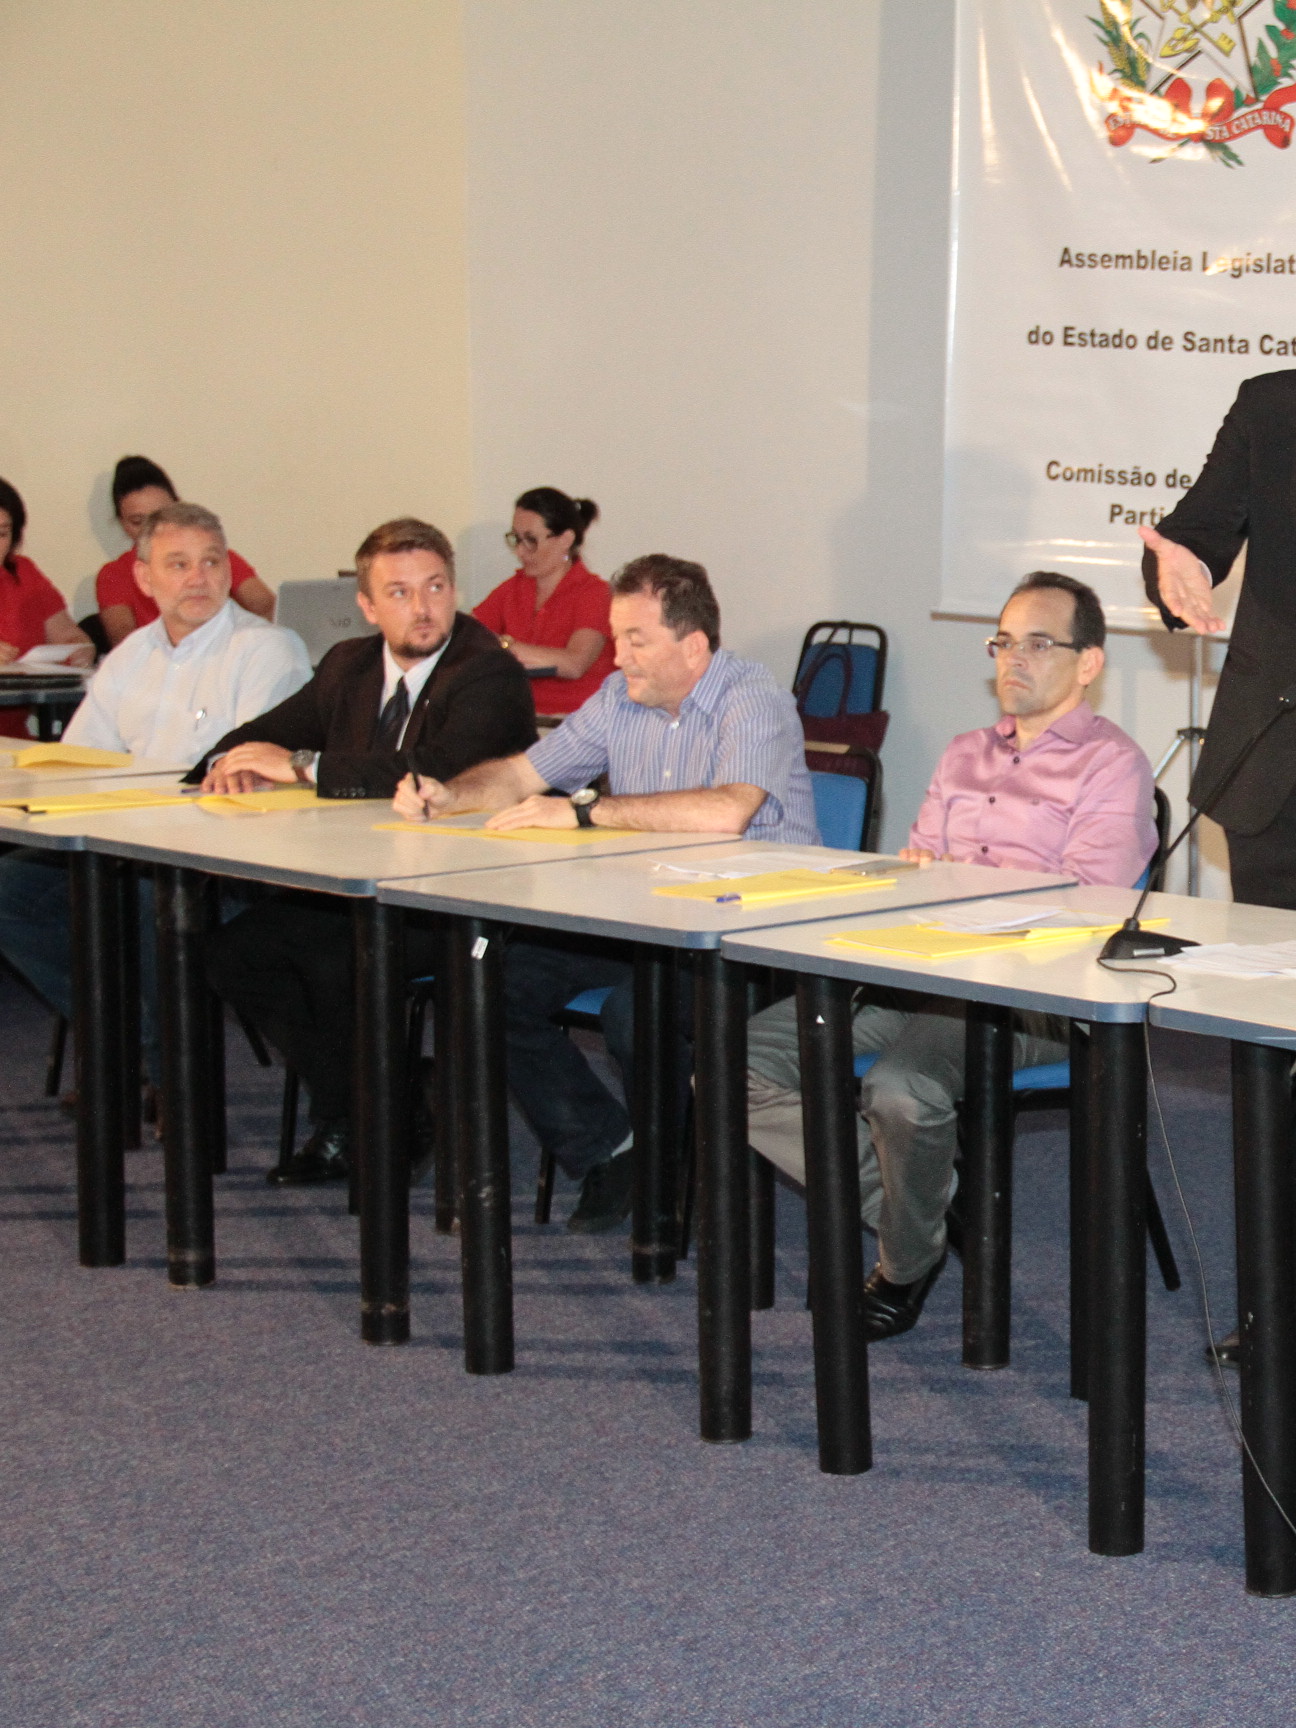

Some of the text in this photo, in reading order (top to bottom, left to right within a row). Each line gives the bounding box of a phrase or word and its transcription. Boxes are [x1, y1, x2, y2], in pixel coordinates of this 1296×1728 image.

[1232, 110, 1291, 133] CATARINA
[1059, 247, 1193, 271] Assembleia
[1027, 325, 1054, 345] do
[1063, 326, 1138, 349] Estado
[1146, 330, 1174, 351] de
[1182, 331, 1249, 355] Santa
[1046, 460, 1193, 489] Comissão de
[1109, 503, 1165, 527] Parti
